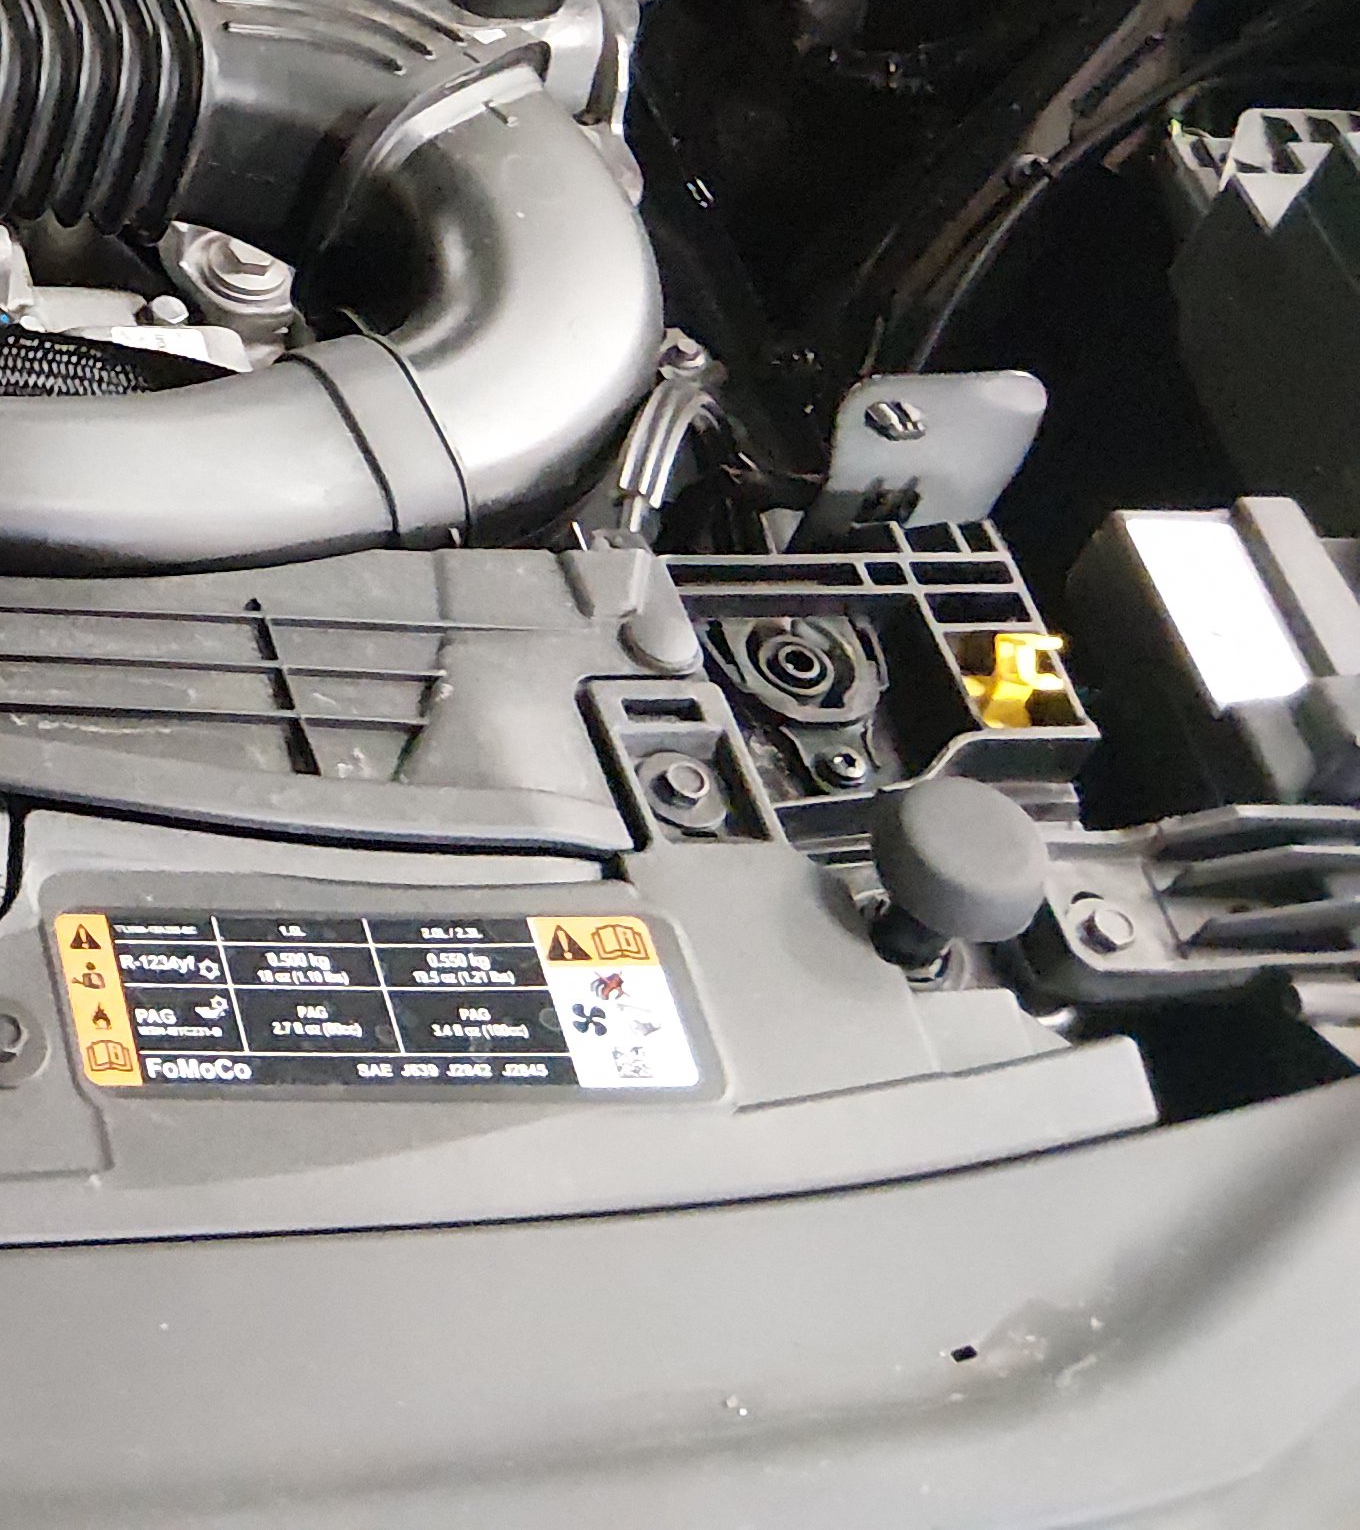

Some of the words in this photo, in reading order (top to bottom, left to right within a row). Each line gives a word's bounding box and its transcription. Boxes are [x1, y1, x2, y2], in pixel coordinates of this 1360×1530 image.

[118, 954, 196, 974] R-1234yf
[135, 1008, 177, 1025] PAG
[296, 1005, 329, 1019] PAG
[458, 1008, 491, 1021] PAG
[145, 1057, 252, 1080] FoMoCo
[356, 1063, 393, 1078] SAE
